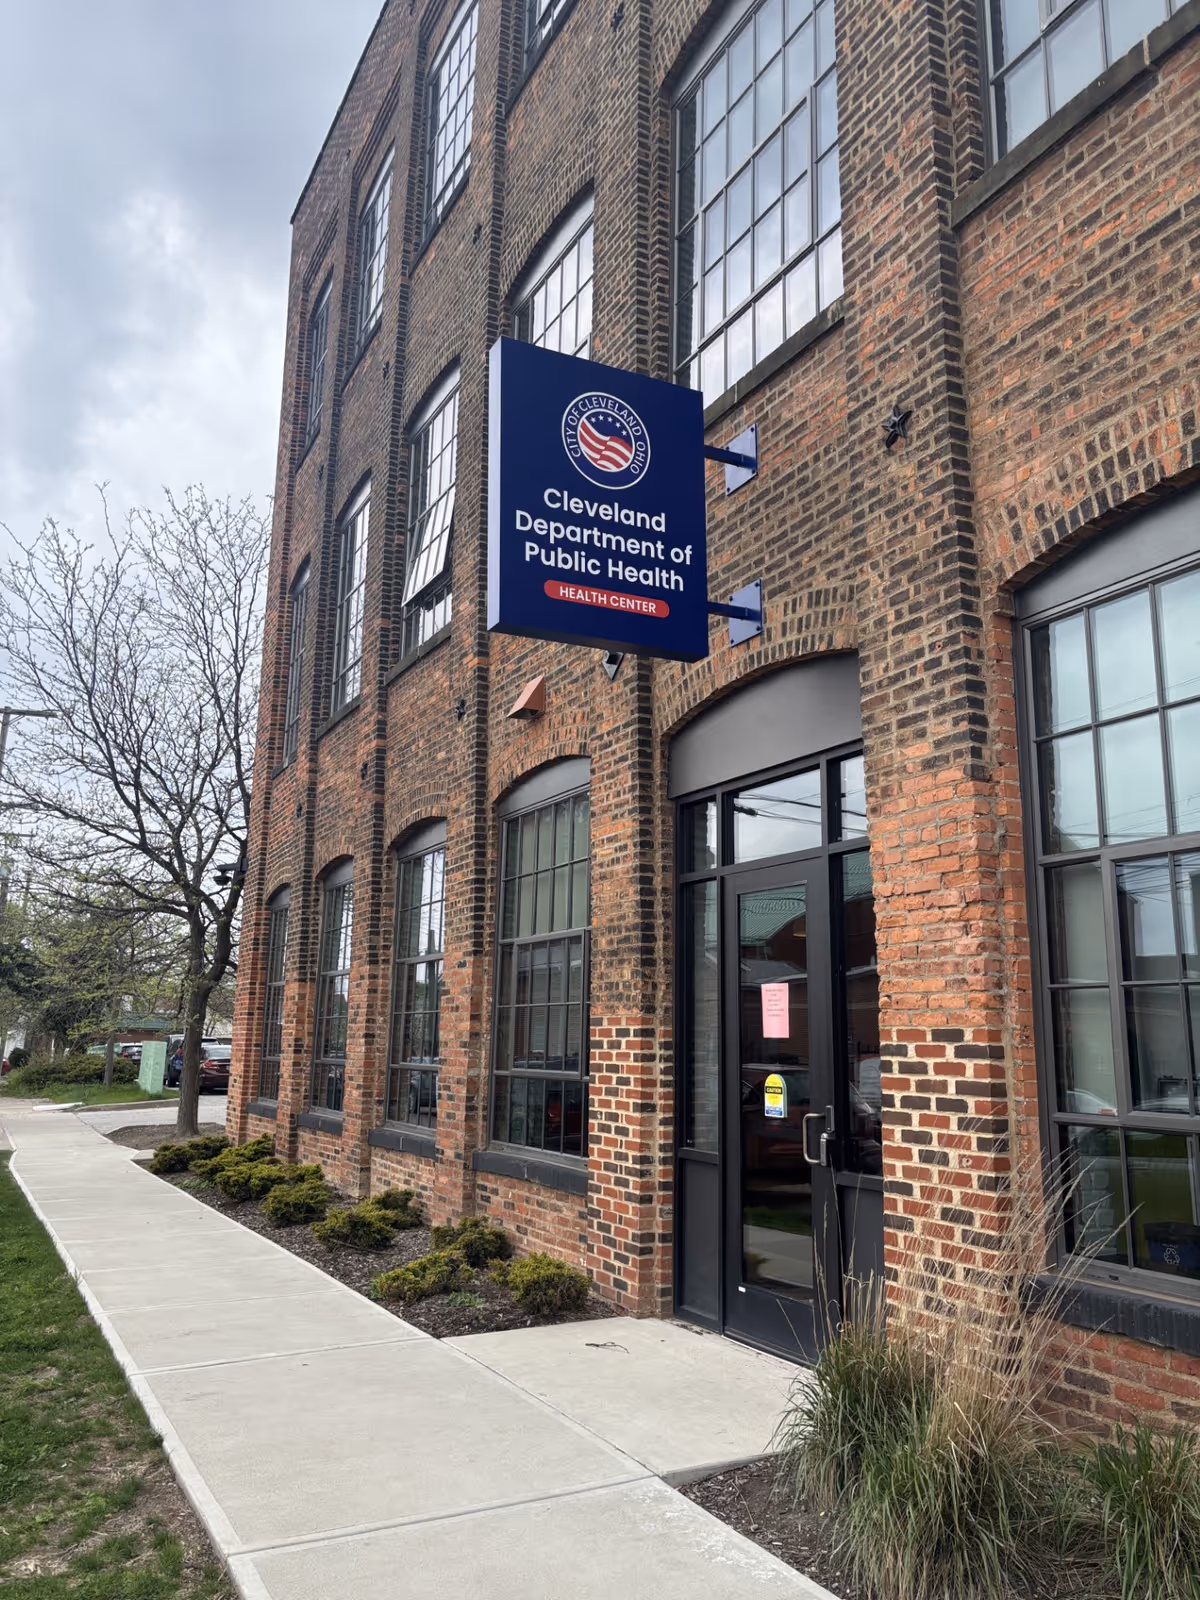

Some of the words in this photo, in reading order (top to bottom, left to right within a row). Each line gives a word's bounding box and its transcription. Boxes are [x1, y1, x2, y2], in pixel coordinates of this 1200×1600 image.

[567, 407, 580, 426] OF
[578, 396, 642, 436] CLEVELAND
[566, 427, 581, 458] CITY
[630, 441, 646, 474] OHIO
[543, 488, 666, 532] Cleveland
[515, 510, 664, 560] Department
[671, 545, 693, 565] of
[525, 541, 601, 575] Public
[608, 559, 684, 592] Health
[559, 585, 607, 605] HEALTH
[610, 595, 657, 614] CENTER
